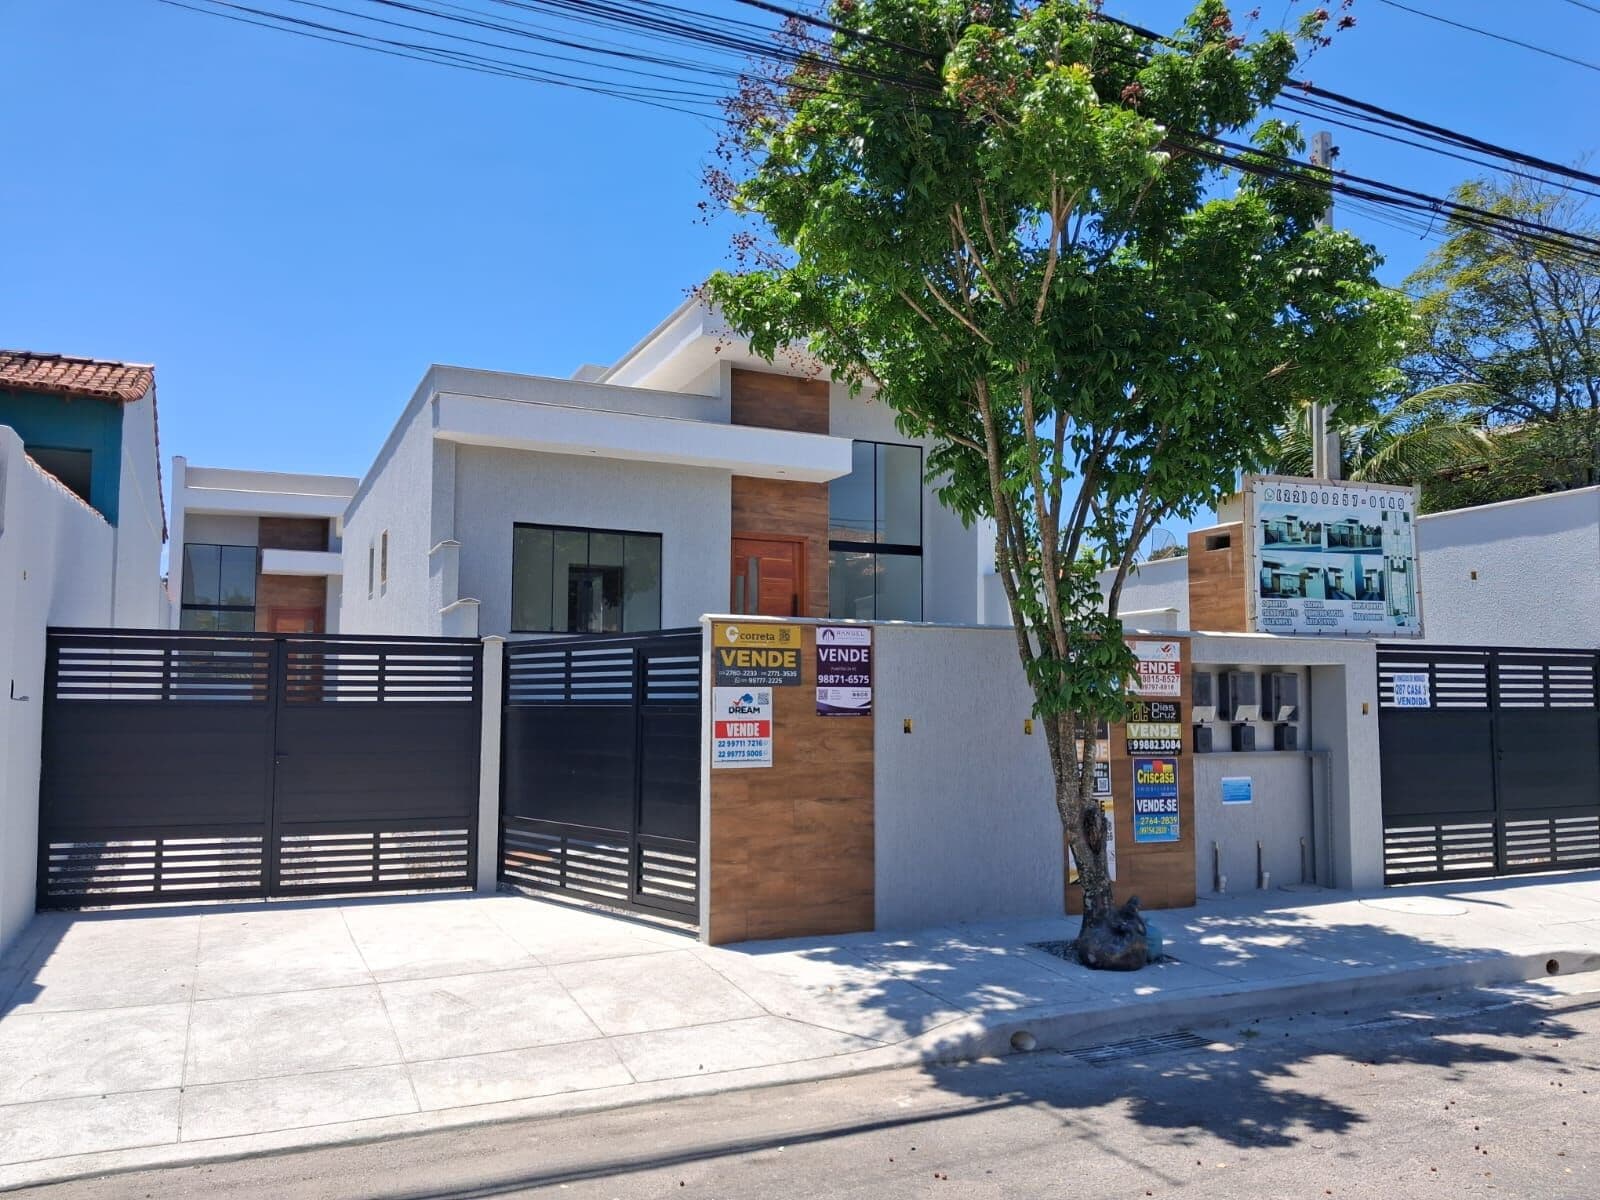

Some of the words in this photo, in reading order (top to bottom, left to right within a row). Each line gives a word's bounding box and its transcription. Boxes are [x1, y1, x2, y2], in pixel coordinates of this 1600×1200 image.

[739, 632, 775, 641] correta
[720, 649, 797, 668] VENDE
[818, 647, 869, 662] VENDE
[817, 674, 870, 684] 98871-6575
[1407, 684, 1421, 695] CASA
[1397, 696, 1427, 705] VENDIDA
[728, 706, 761, 714] DREAM
[1151, 702, 1175, 712] Dias
[1151, 711, 1176, 719] Cruz
[726, 722, 760, 737] VENDE
[1129, 724, 1179, 738] VENDE
[1136, 768, 1175, 784] Criscasa
[1136, 799, 1177, 813] VENDE-SE
